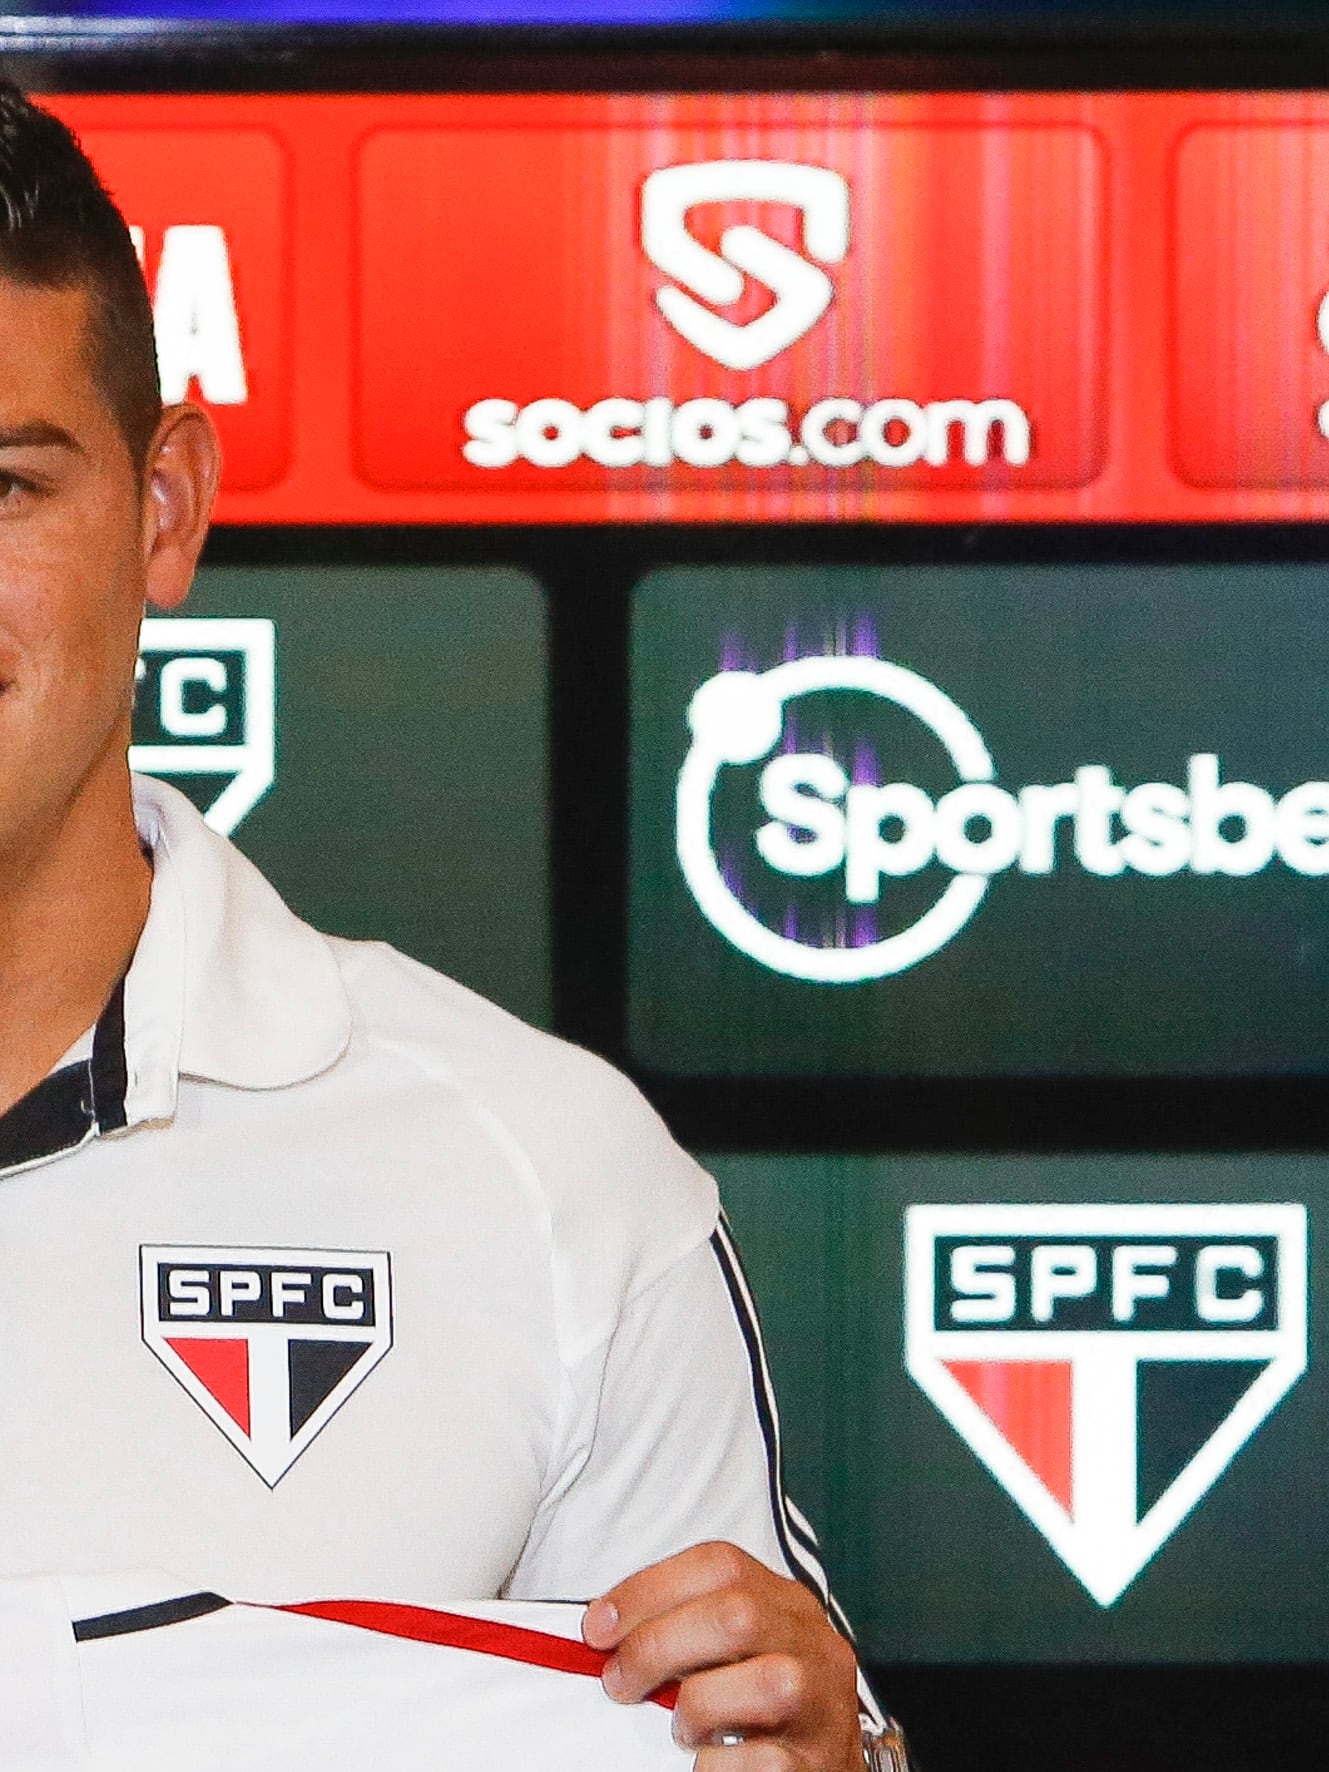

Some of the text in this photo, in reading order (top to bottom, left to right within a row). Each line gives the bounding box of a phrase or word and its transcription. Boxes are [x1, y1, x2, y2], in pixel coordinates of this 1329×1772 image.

[462, 396, 1030, 468] socios.com
[167, 1268, 365, 1320] SPFC
[950, 1244, 1264, 1322] SPFC
